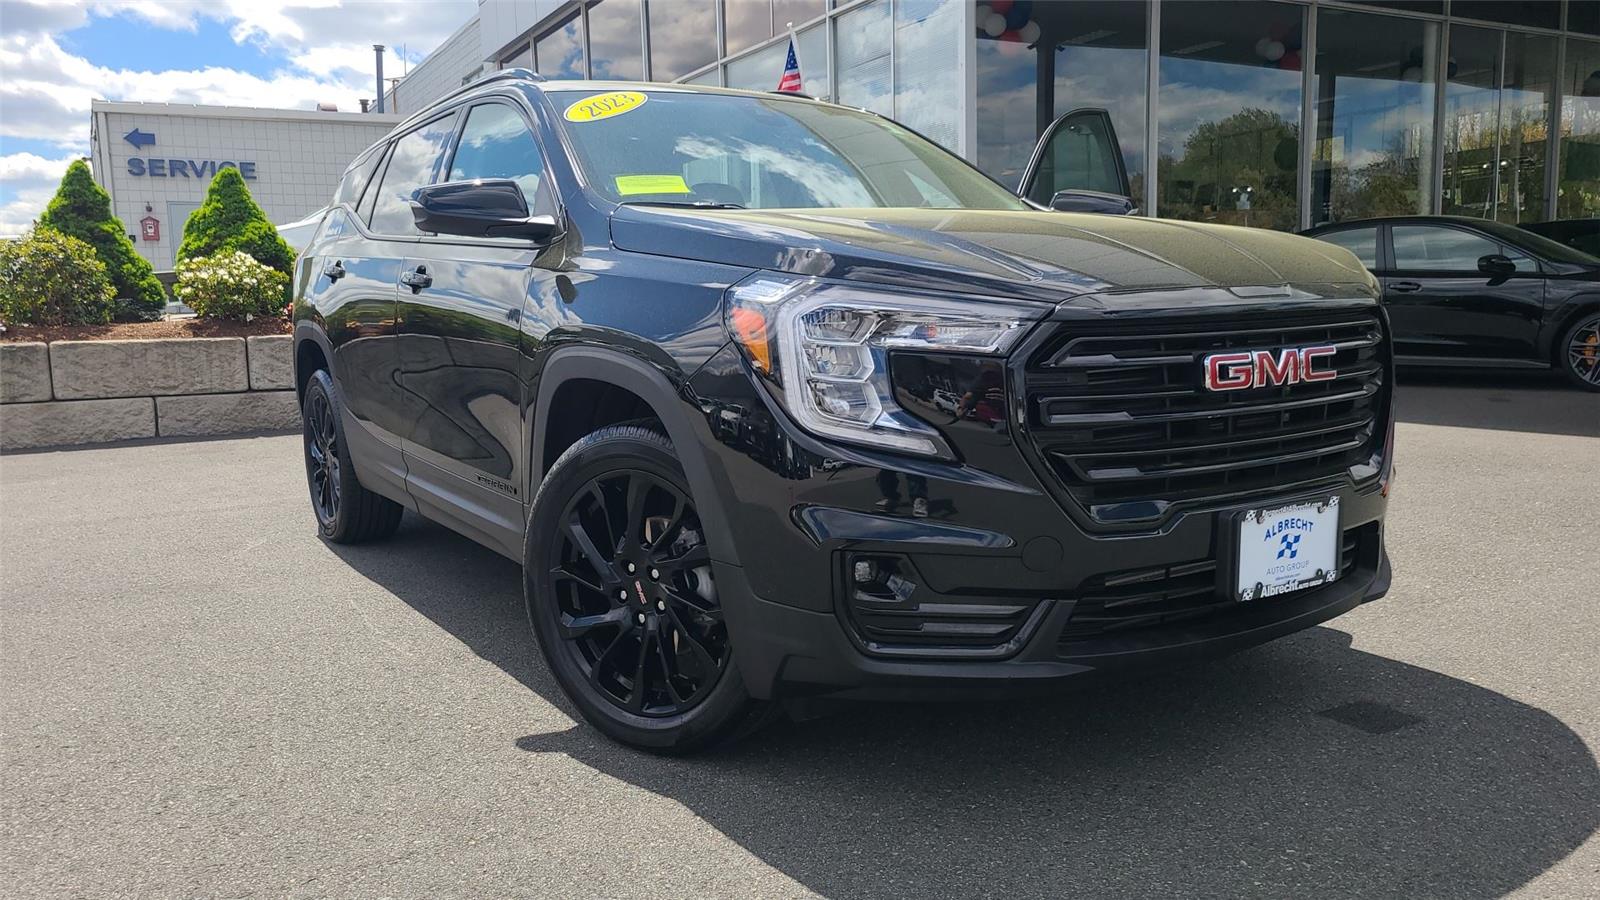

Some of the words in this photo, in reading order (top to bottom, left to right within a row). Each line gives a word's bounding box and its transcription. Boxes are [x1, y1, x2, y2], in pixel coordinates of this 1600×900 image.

[580, 93, 635, 118] 2023
[1204, 345, 1337, 391] GMC
[1264, 517, 1314, 542] ALBRECHT
[1266, 565, 1286, 576] AUTO
[1286, 560, 1310, 572] GROUP
[1260, 580, 1299, 598] Albrecht
